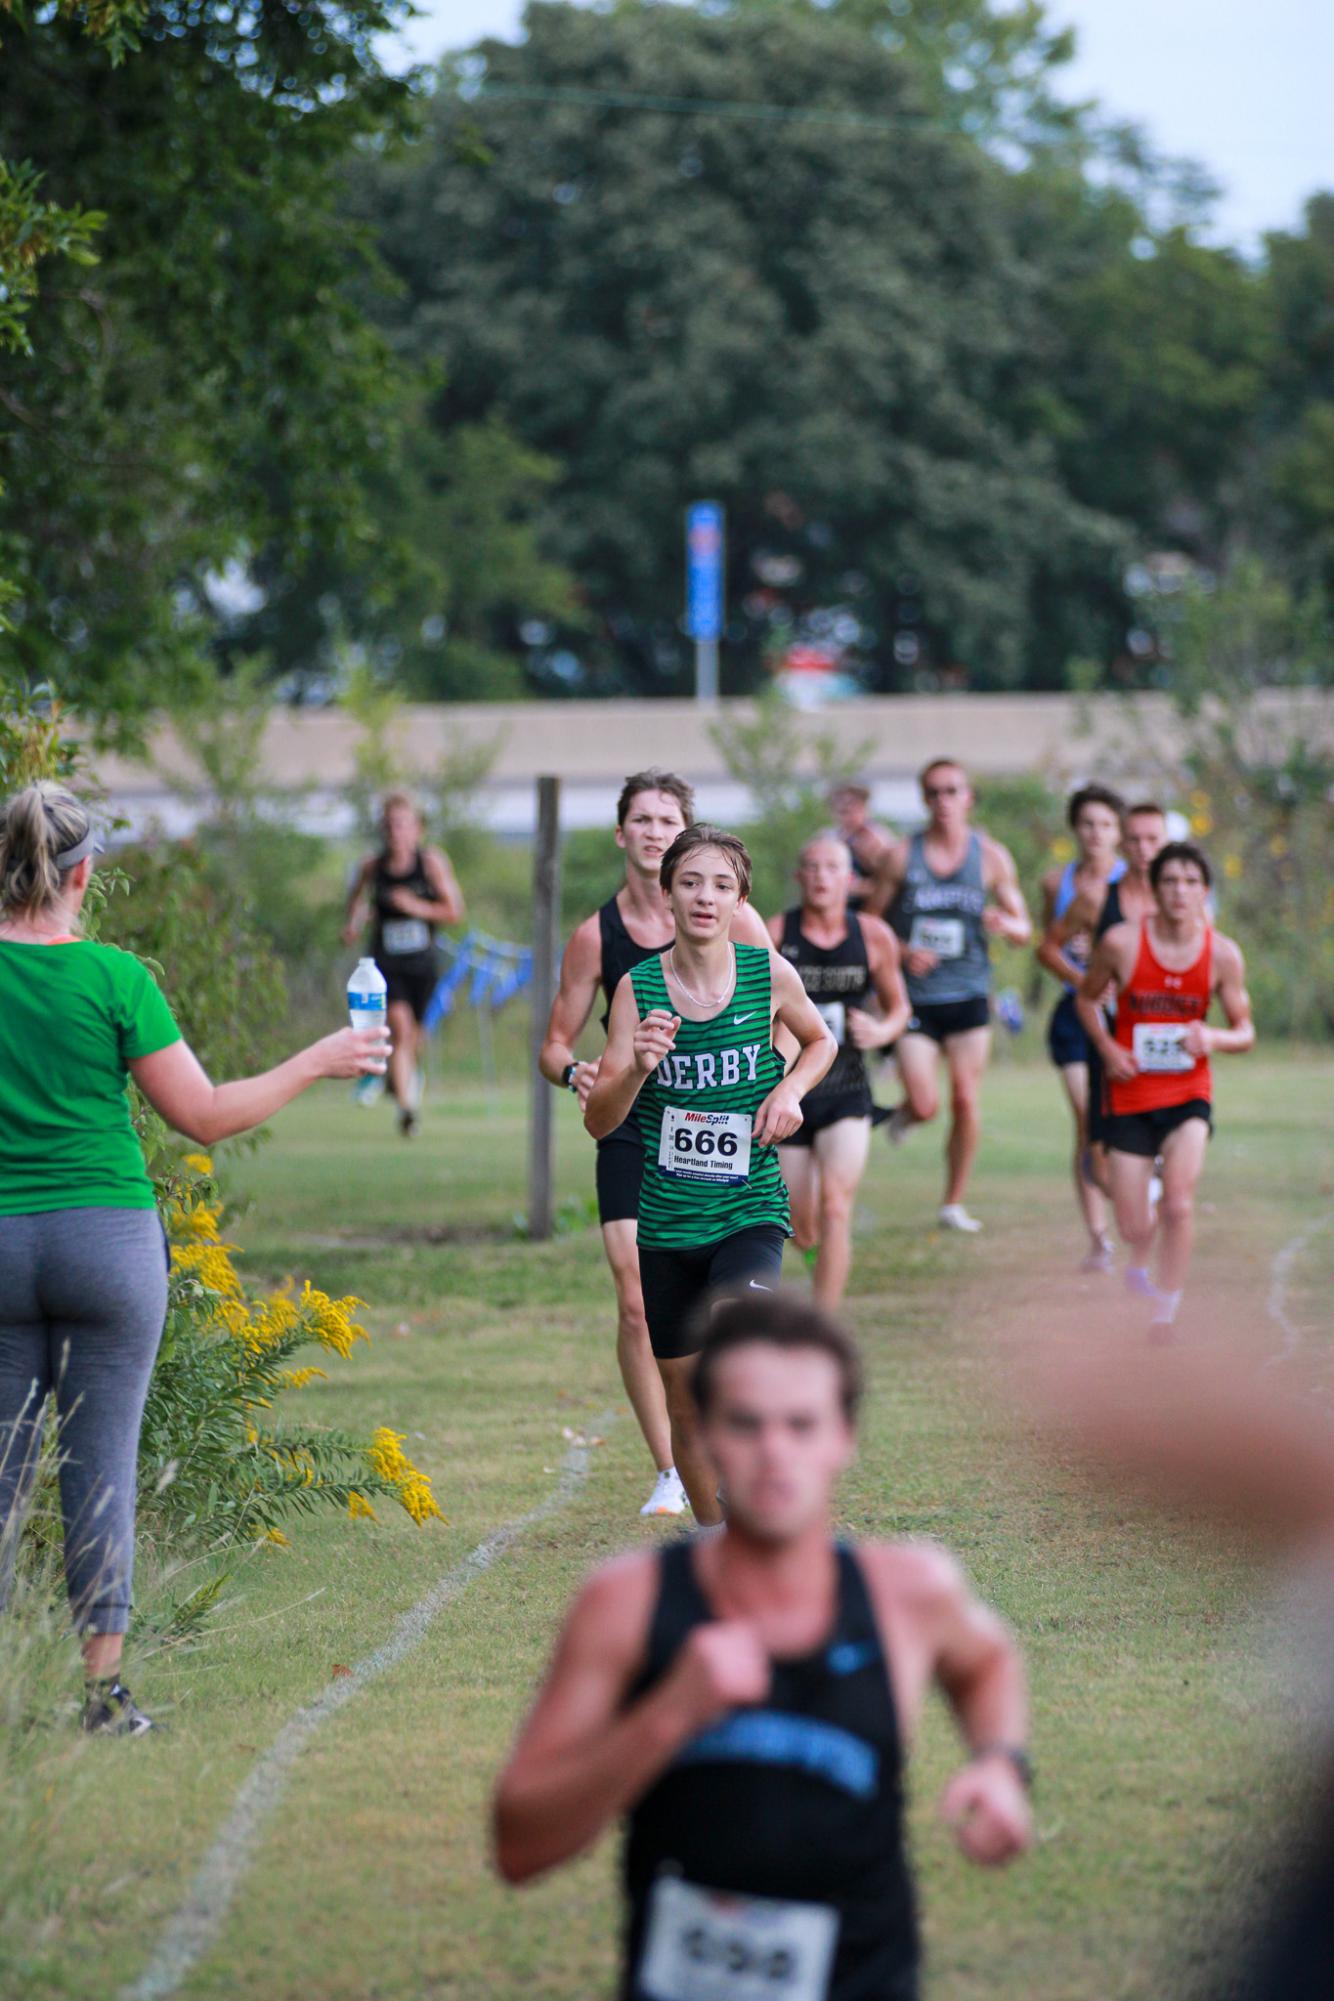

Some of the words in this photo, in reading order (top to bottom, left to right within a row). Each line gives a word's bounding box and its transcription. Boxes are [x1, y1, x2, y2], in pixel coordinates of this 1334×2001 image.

[657, 1044, 761, 1089] DERBY
[685, 1112, 730, 1125] MileSplit
[674, 1128, 738, 1156] 666
[673, 1155, 708, 1168] Heartland
[710, 1160, 733, 1170] Timing
